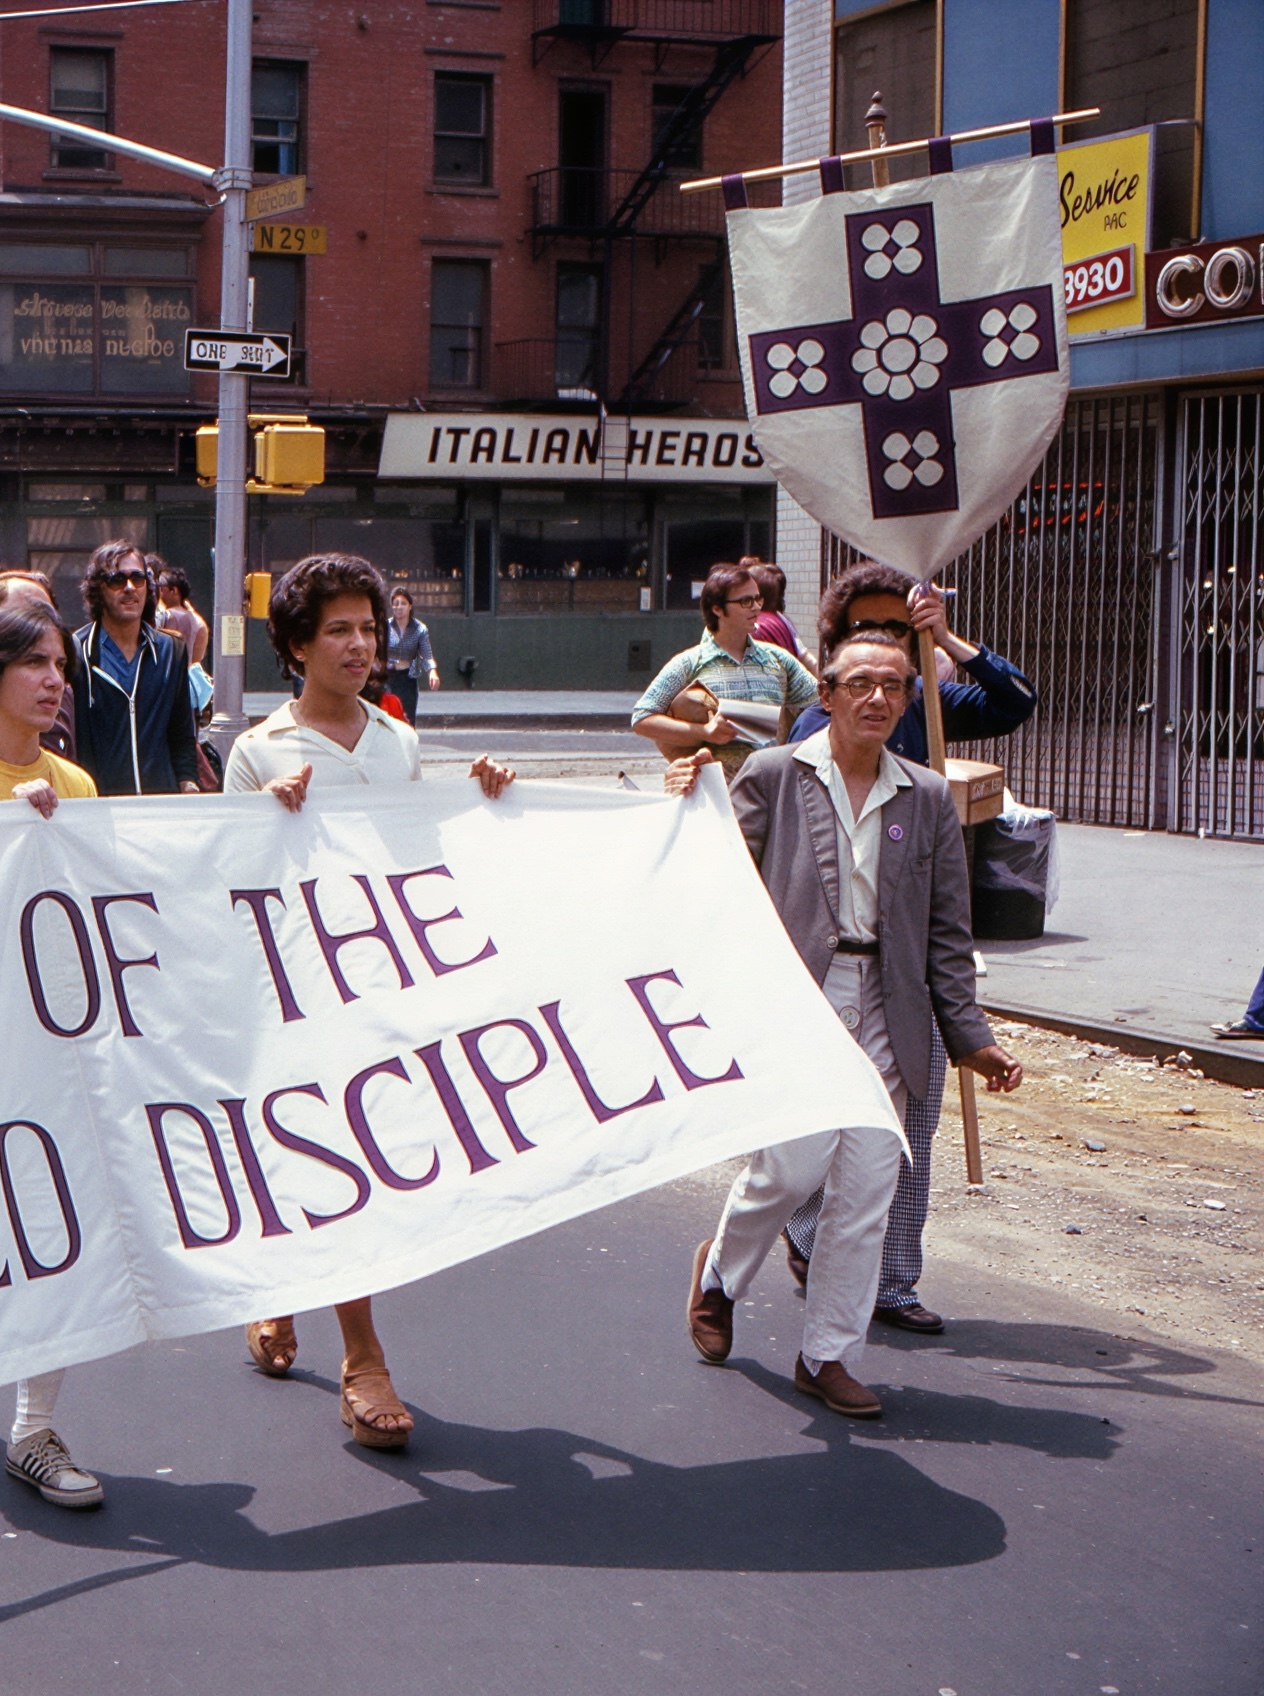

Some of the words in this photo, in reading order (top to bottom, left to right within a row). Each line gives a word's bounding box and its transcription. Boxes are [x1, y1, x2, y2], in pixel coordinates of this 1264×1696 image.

[1156, 244, 1264, 318] CO
[196, 342, 227, 360] ONE
[427, 426, 600, 465] ITALIAN
[627, 429, 765, 469] HEROS
[19, 889, 161, 1038] OF
[229, 864, 499, 1023] THE
[144, 968, 745, 1249] DISCIPLE
